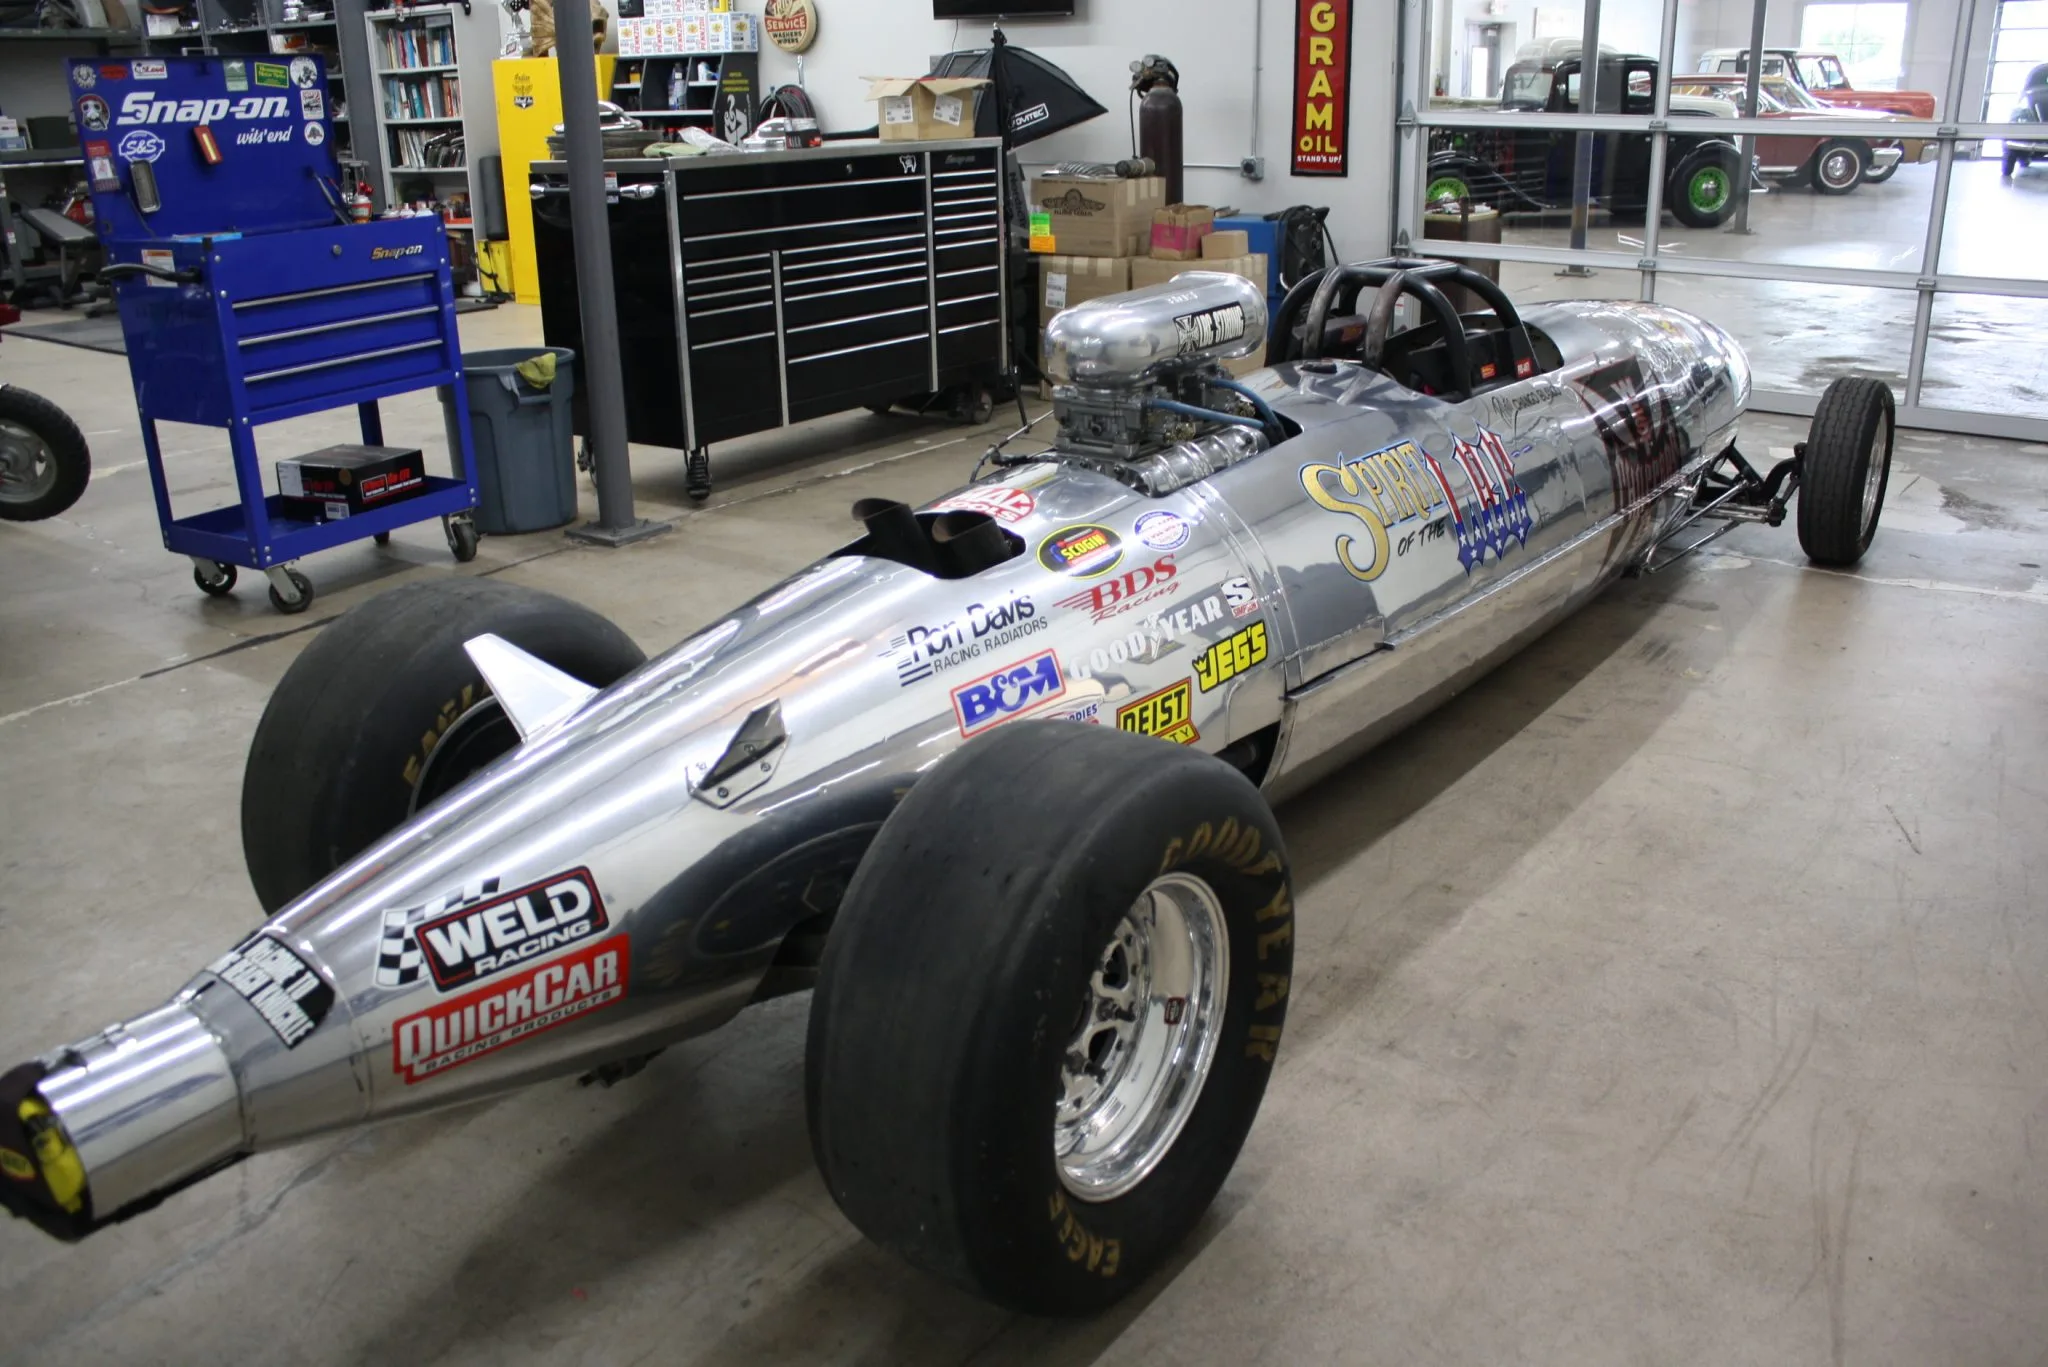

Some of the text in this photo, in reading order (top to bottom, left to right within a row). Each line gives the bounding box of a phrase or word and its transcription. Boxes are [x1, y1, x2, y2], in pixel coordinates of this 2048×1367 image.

[766, 16, 806, 30] SERVICE
[116, 91, 288, 126] Snap-on
[126, 139, 157, 155] S&S
[1297, 155, 1342, 163] STAND'S UP!
[1300, 135, 1338, 153] OIL
[371, 244, 423, 260] Snap-on
[1299, 440, 1444, 582] SPIRIT
[1060, 533, 1107, 561] SCOGIN
[1397, 518, 1446, 556] OF THE
[1089, 553, 1177, 612] BDS
[1090, 580, 1181, 624] Racing
[906, 588, 1035, 663] Ron Davis
[933, 616, 1049, 674] RACING RADIATORS
[1200, 622, 1267, 692] JEG'S
[957, 654, 1062, 729] B&M
[424, 878, 592, 968] WELD
[474, 918, 593, 976] RACING
[425, 989, 612, 1072] RACING PRODUCTS
